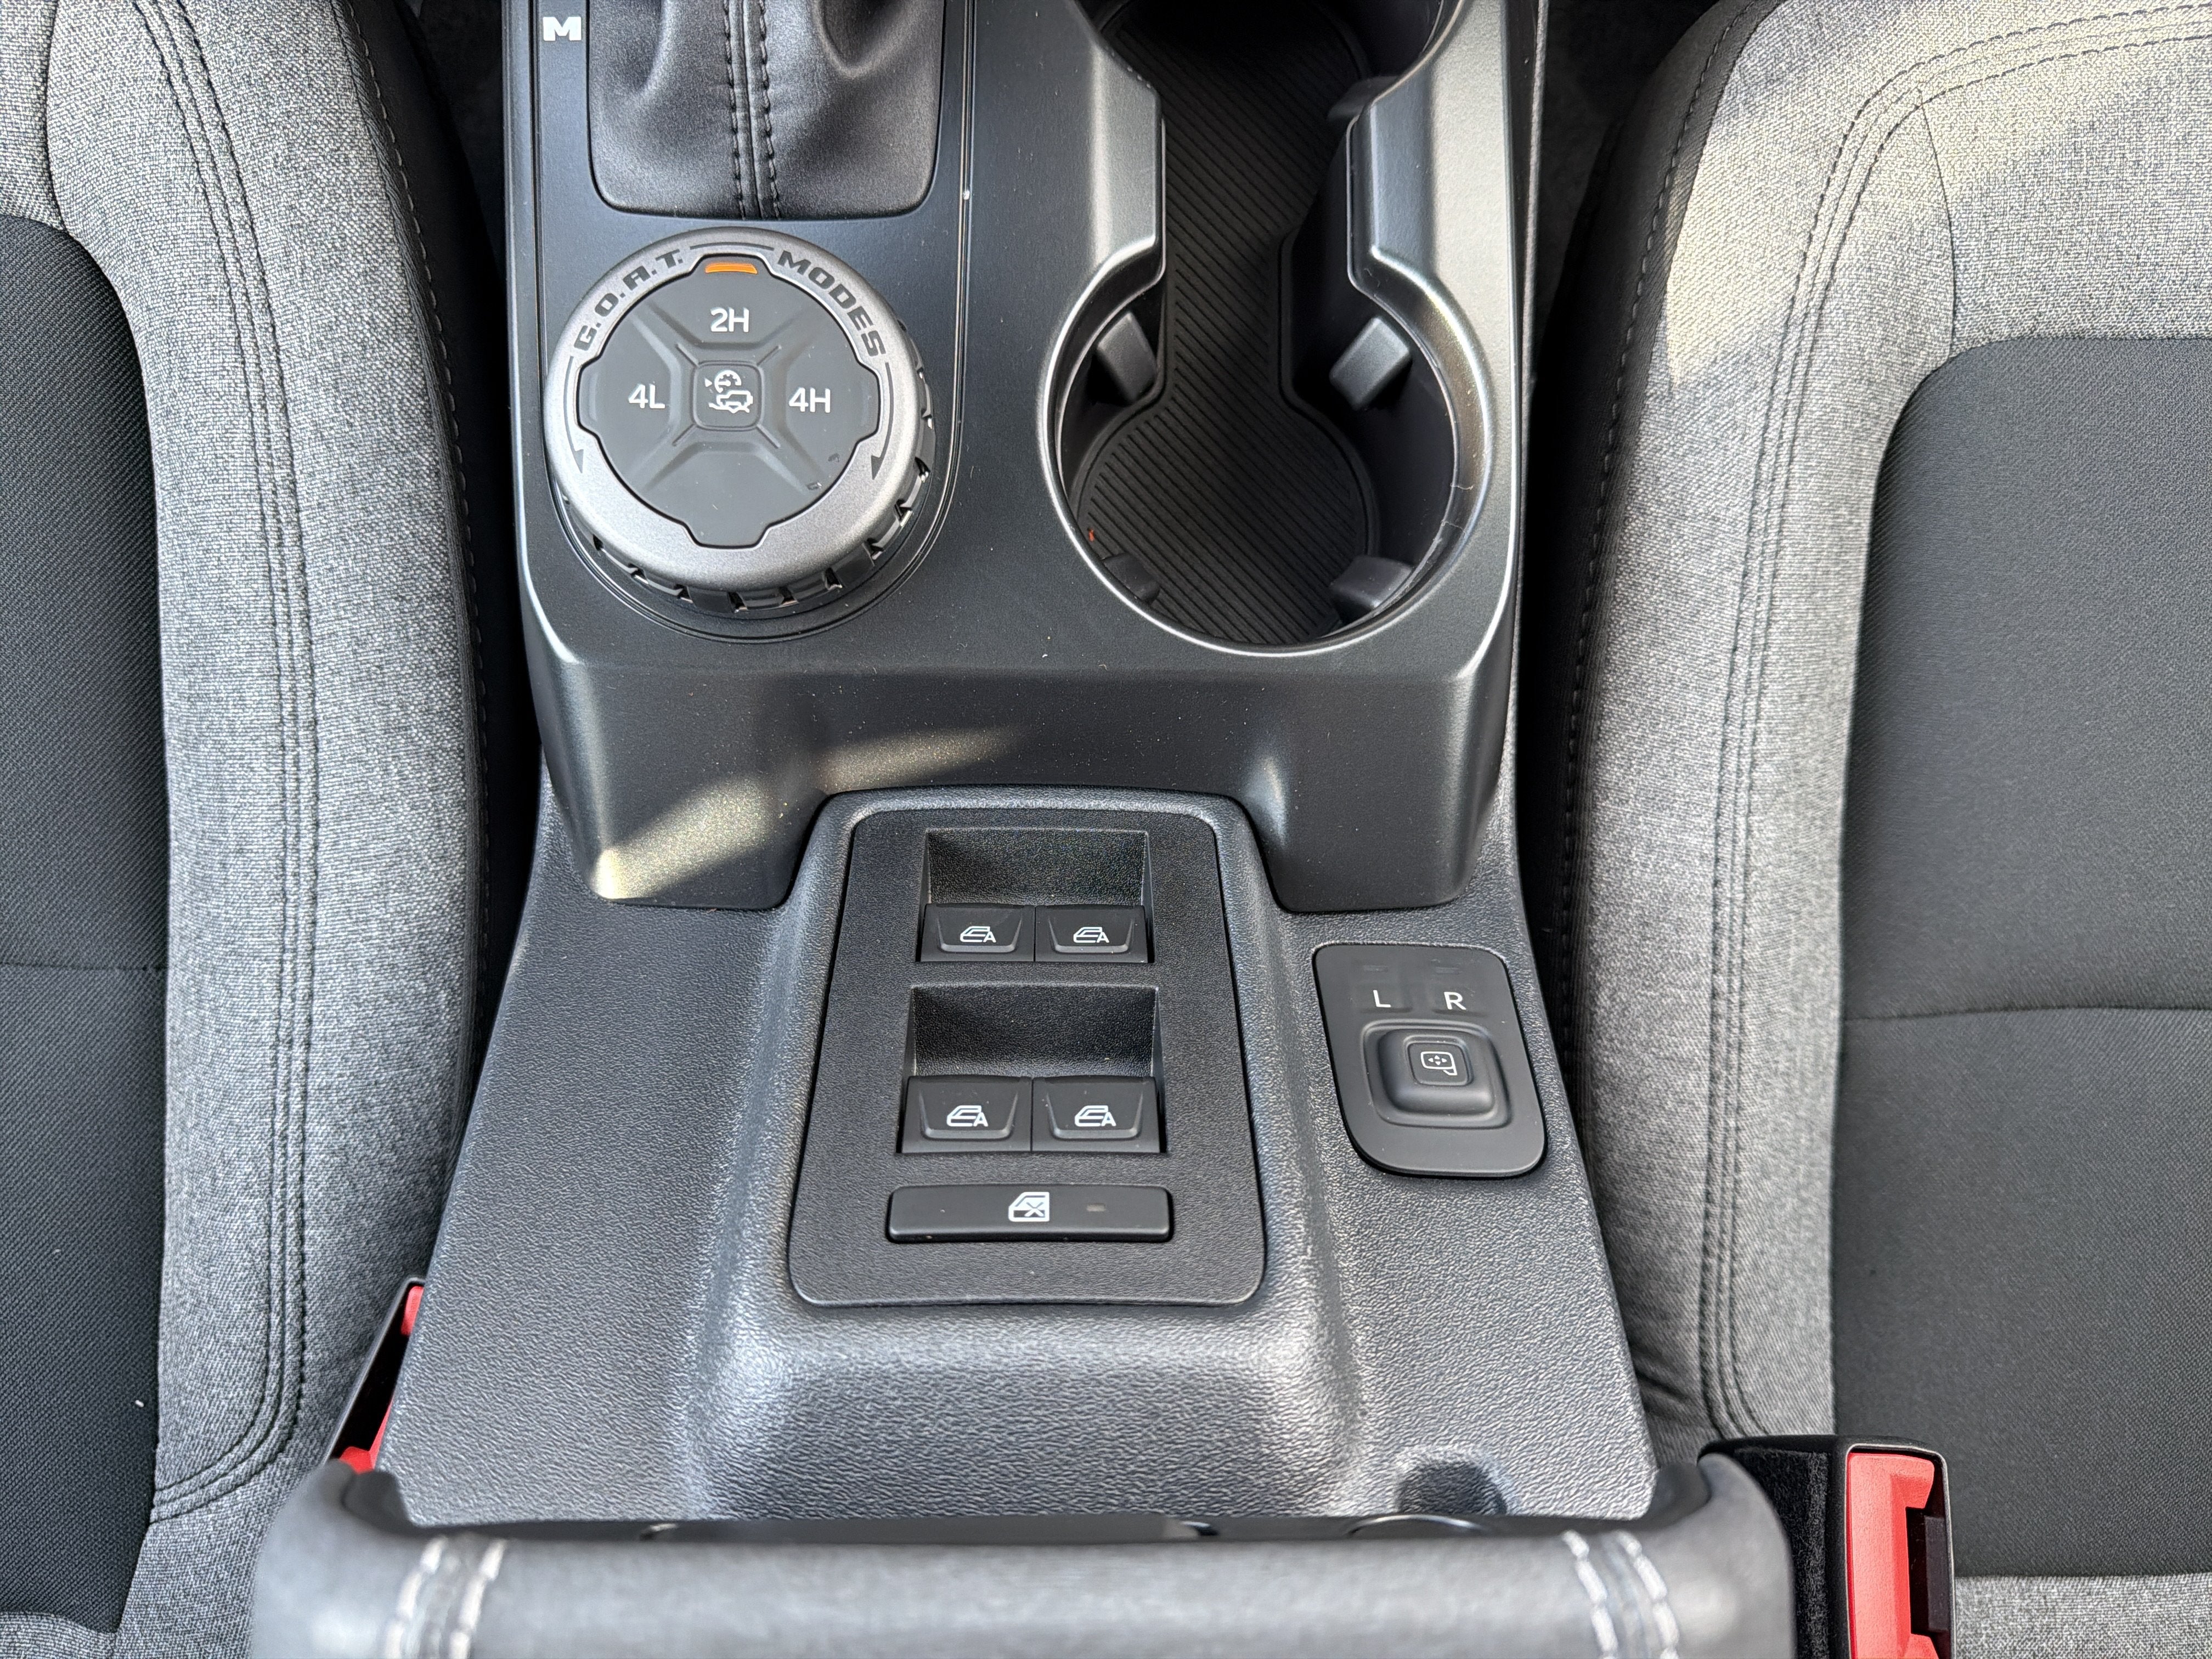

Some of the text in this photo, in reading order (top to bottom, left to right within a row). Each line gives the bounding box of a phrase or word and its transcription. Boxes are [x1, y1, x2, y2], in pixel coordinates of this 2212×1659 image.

[543, 16, 582, 41] M
[574, 249, 886, 357] G.O.A.T. MODES
[710, 308, 749, 332] 2H
[628, 385, 665, 409] 4L
[788, 387, 831, 413] 4H
[1373, 990, 1391, 1008] L
[1443, 991, 1466, 1010] R
